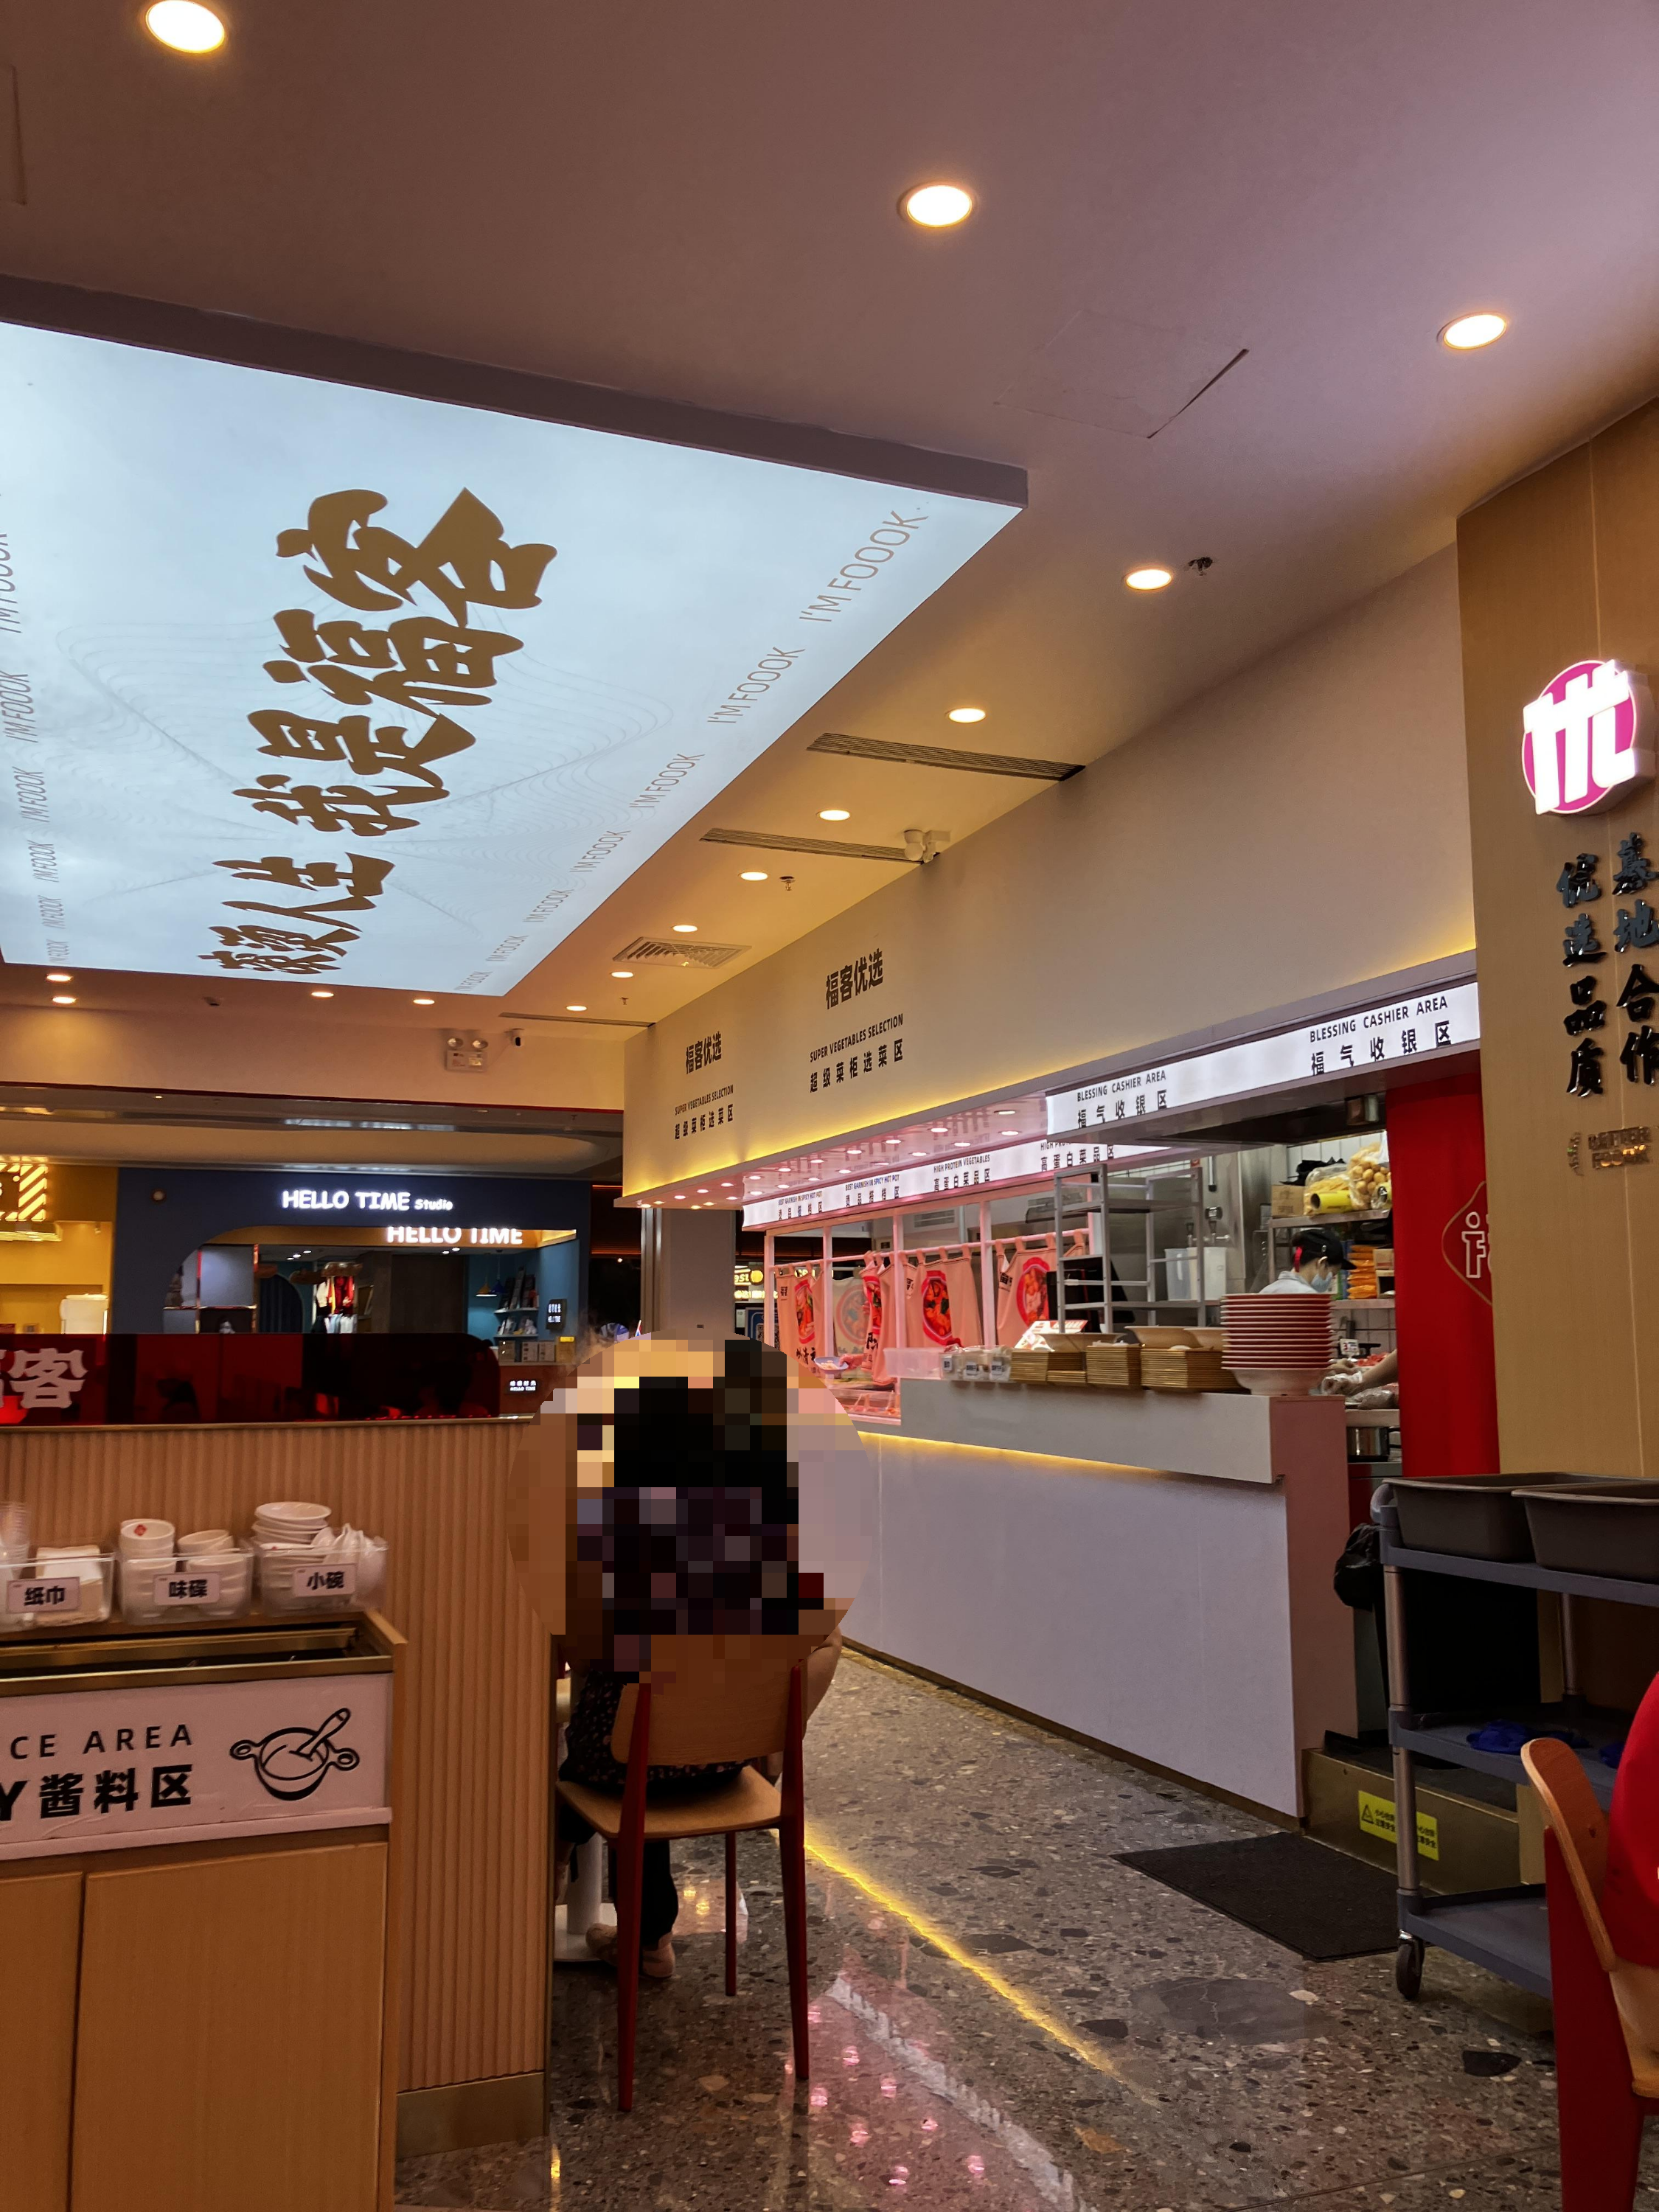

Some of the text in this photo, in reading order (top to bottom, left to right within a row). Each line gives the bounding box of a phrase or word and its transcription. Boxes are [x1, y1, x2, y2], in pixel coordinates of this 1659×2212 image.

[799, 510, 928, 622] I'M FOOOK
[232, 487, 557, 837] 我是福客
[0, 670, 36, 722] FOOOK
[707, 647, 806, 723] I'M FOOOK
[12, 766, 48, 807] FOOOK
[644, 754, 706, 791] FOOOK
[581, 830, 631, 860] FOOOK
[825, 948, 883, 1009] 福客优选
[810, 1013, 903, 1062] SUPER VEGETABLES SELECTION
[1310, 995, 1448, 1043] BLESSING CASHIER AREA
[686, 1031, 722, 1074] 福客优选
[810, 1038, 903, 1093] 超级菜柜选菜区
[1312, 1020, 1451, 1077] 福气收银区
[675, 1084, 734, 1116] SUPER VEGETABLES SELECTION
[1077, 1070, 1166, 1102] BLESSING CASHIER AREA
[675, 1104, 734, 1140] 超级菜柜选菜区
[1078, 1089, 1167, 1128] 福气收银区
[933, 1154, 990, 1173] HIGH PROTEIN VEGETABLES
[282, 1190, 453, 1211] HELLO TIME Studio
[387, 1226, 462, 1243] HELLO
[0, 1348, 88, 1408] 客
[24, 1585, 66, 1606] 纸巾
[169, 1579, 207, 1599] 味碟
[306, 1571, 344, 1590] 小碗
[82, 1724, 192, 1755] AREA
